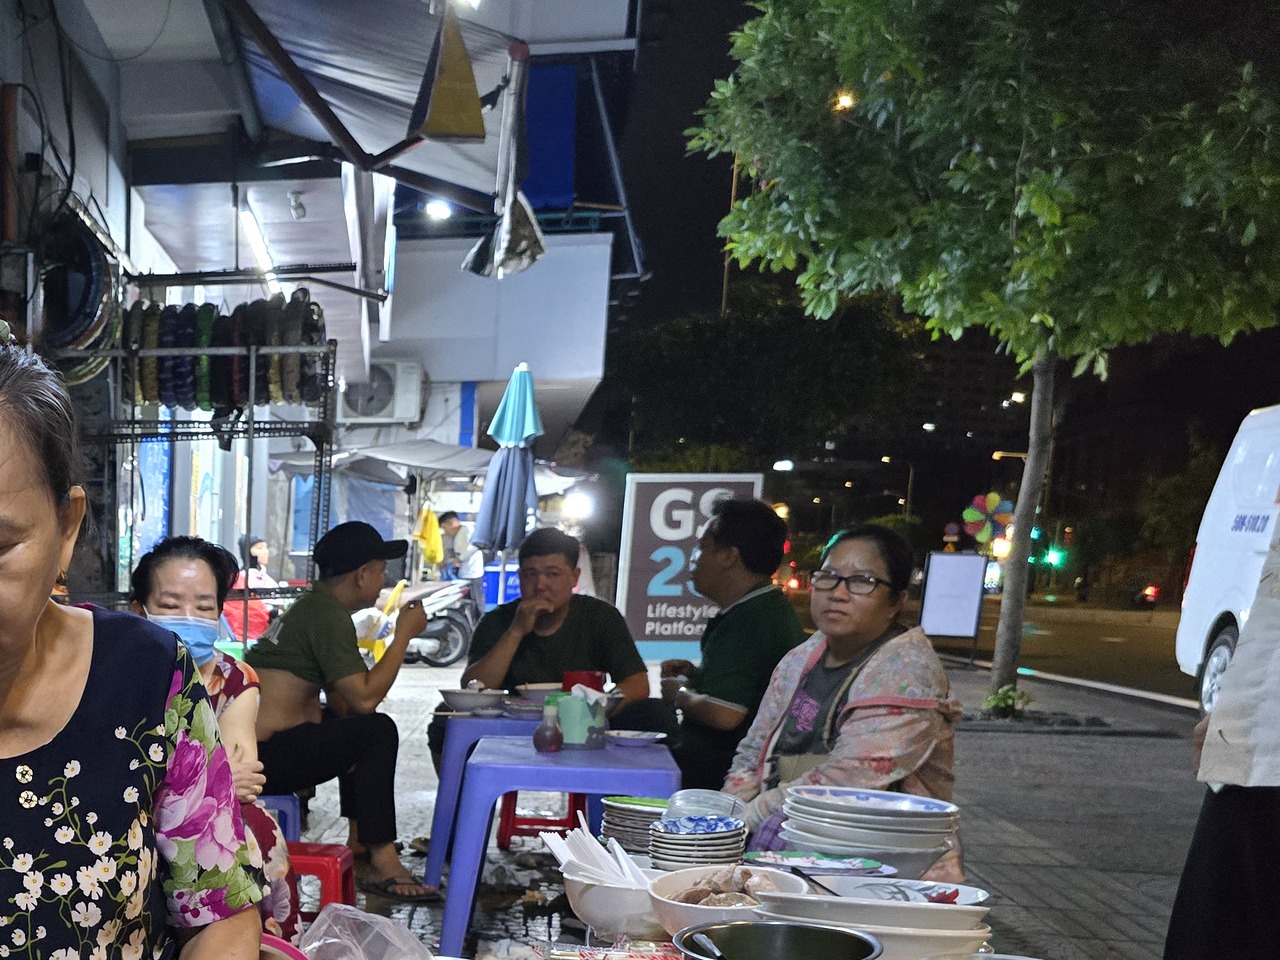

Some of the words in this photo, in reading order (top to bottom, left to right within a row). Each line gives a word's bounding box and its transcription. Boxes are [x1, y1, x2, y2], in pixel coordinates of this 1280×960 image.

[647, 545, 704, 598] 2
[647, 602, 720, 622] Lifestyle
[645, 621, 707, 636] Platfor
